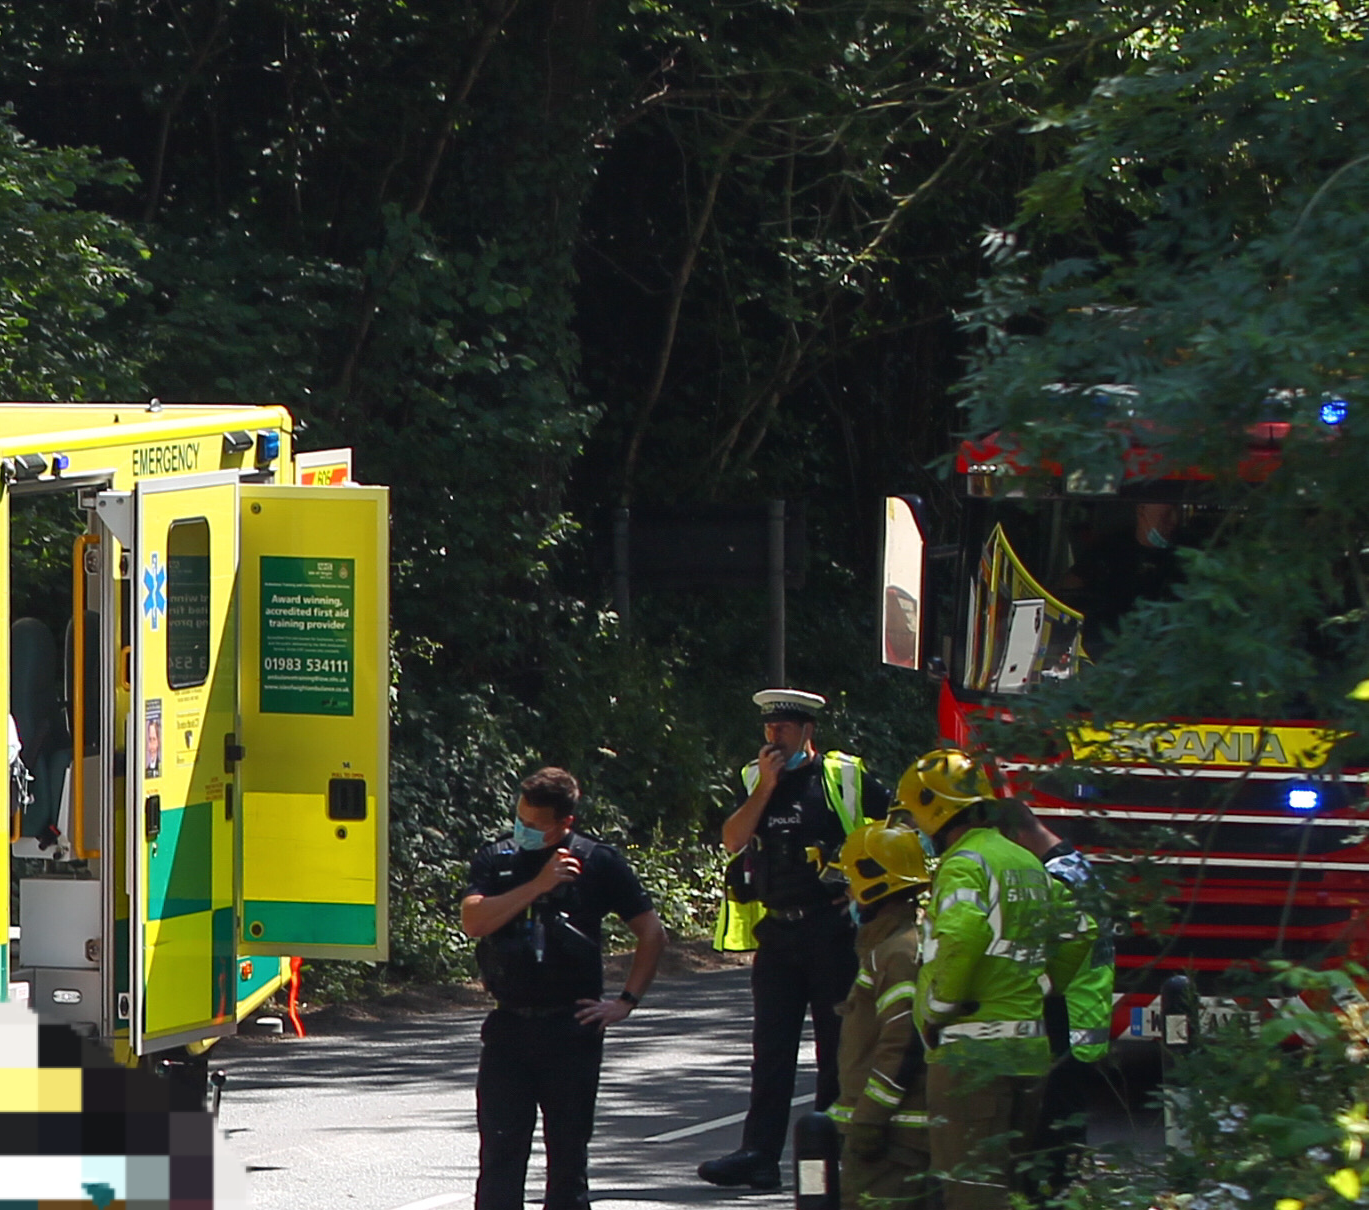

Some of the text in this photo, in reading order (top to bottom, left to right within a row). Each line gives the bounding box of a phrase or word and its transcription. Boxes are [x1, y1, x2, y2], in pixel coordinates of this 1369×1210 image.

[132, 443, 200, 477] EMERGENCY
[271, 594, 343, 607] Award winning,
[265, 606, 350, 618] accredited first aid
[269, 619, 346, 630] training provider
[264, 657, 349, 673] 01983 534111
